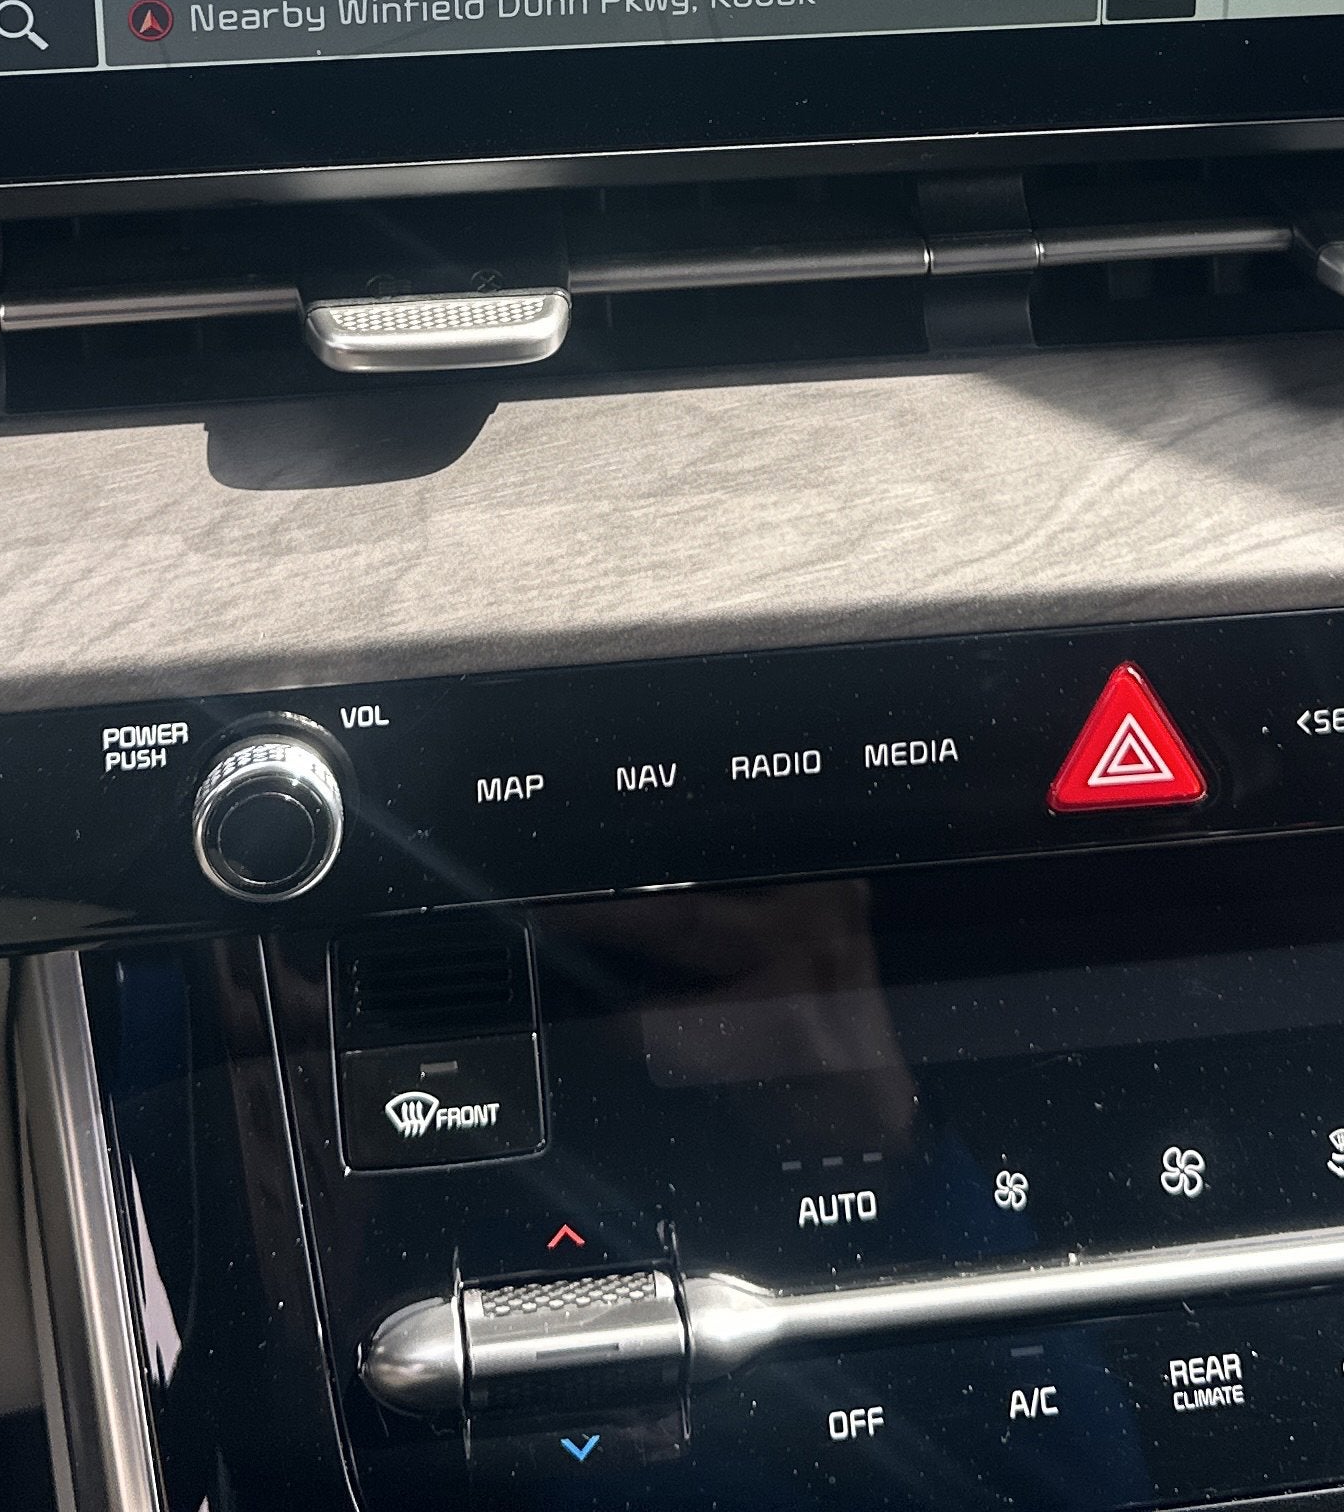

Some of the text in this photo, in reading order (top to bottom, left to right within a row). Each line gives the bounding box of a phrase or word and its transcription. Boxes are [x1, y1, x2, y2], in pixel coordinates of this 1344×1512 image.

[190, 0, 325, 32] Nearby
[340, 705, 390, 729] VOL
[102, 722, 189, 748] POWER
[103, 747, 167, 772] PUSH
[731, 750, 821, 780] RADIO
[865, 738, 959, 768] MEDIA
[477, 774, 544, 803] MAP
[616, 762, 677, 791] NAV
[436, 1100, 500, 1129] FRONT
[798, 1190, 877, 1227] AUTO
[1169, 1354, 1240, 1385] REAR
[1009, 1385, 1059, 1419] A/C
[1171, 1383, 1245, 1411] CLIMATE
[828, 1406, 884, 1440] OFF
